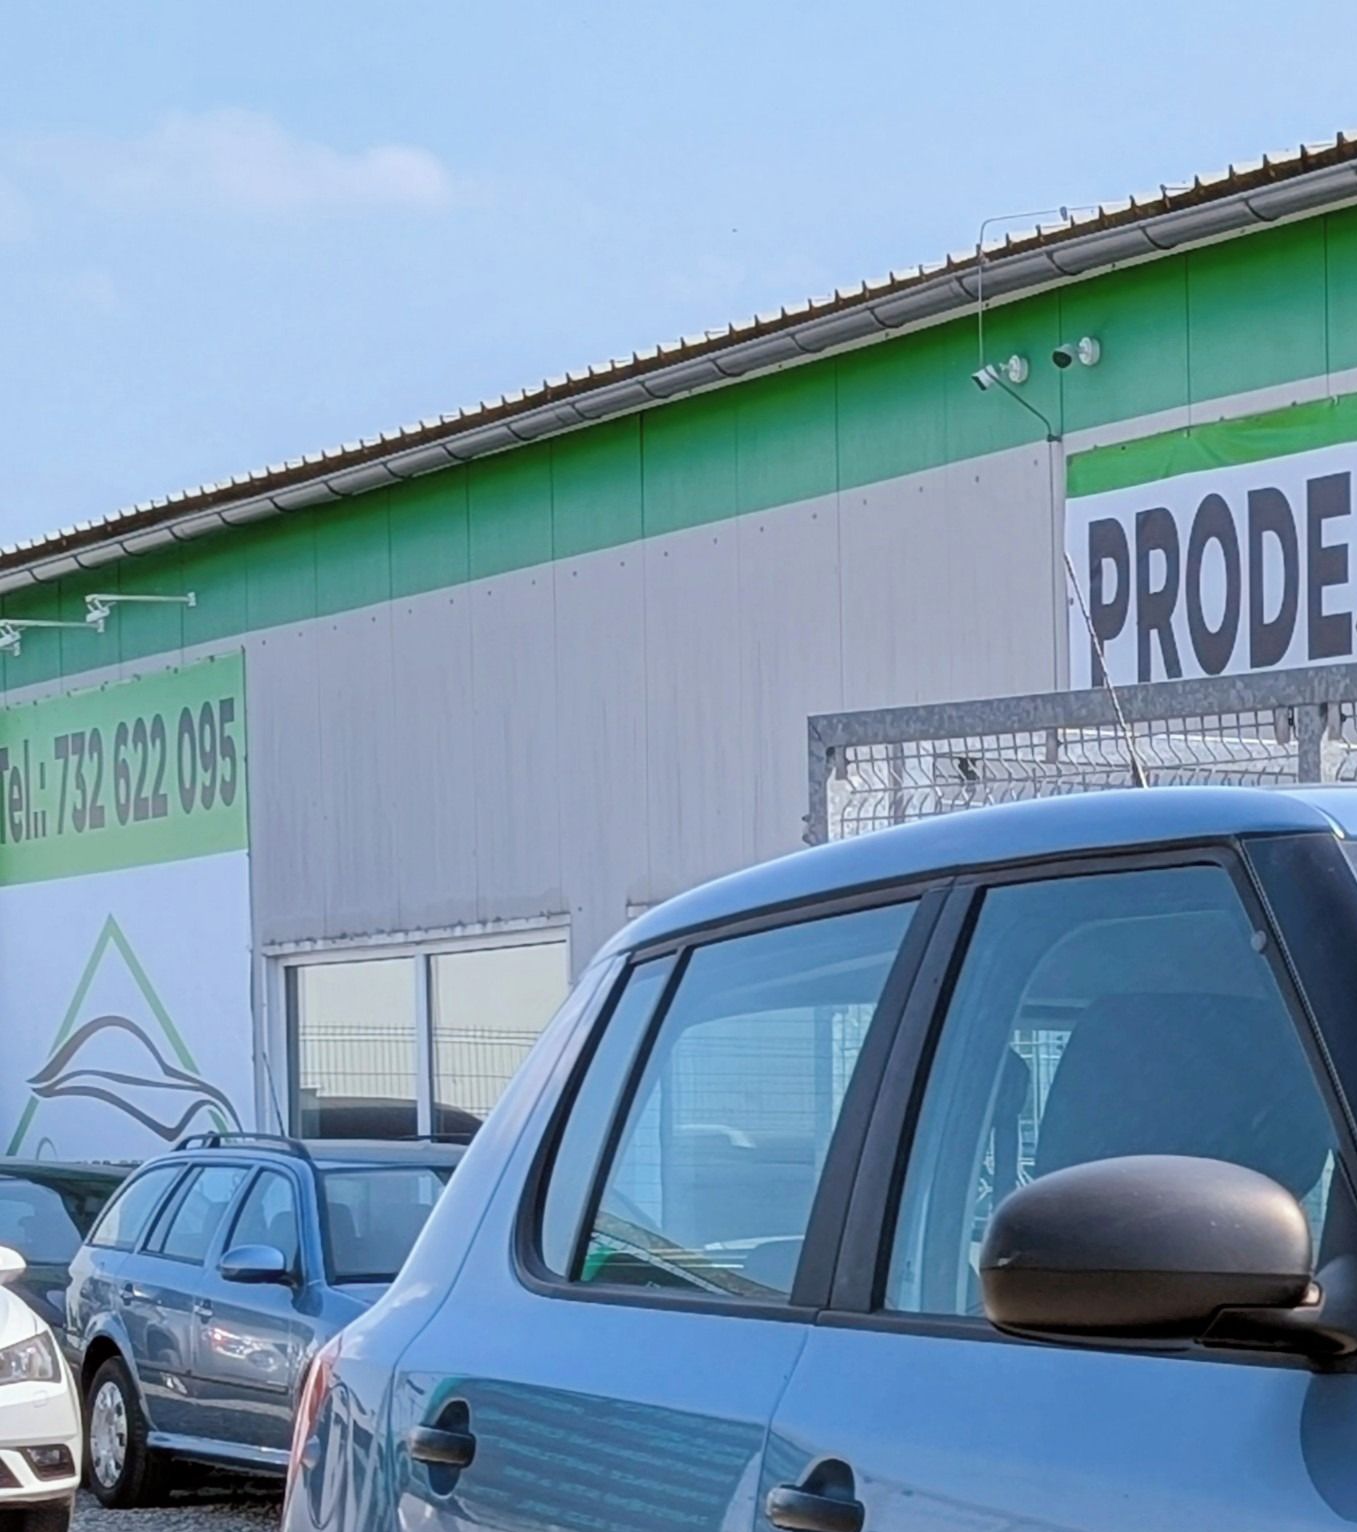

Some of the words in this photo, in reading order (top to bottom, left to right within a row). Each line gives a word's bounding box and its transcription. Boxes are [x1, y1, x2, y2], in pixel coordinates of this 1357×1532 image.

[54, 727, 106, 835] 732
[113, 713, 168, 827] 622
[177, 697, 238, 815] 095
